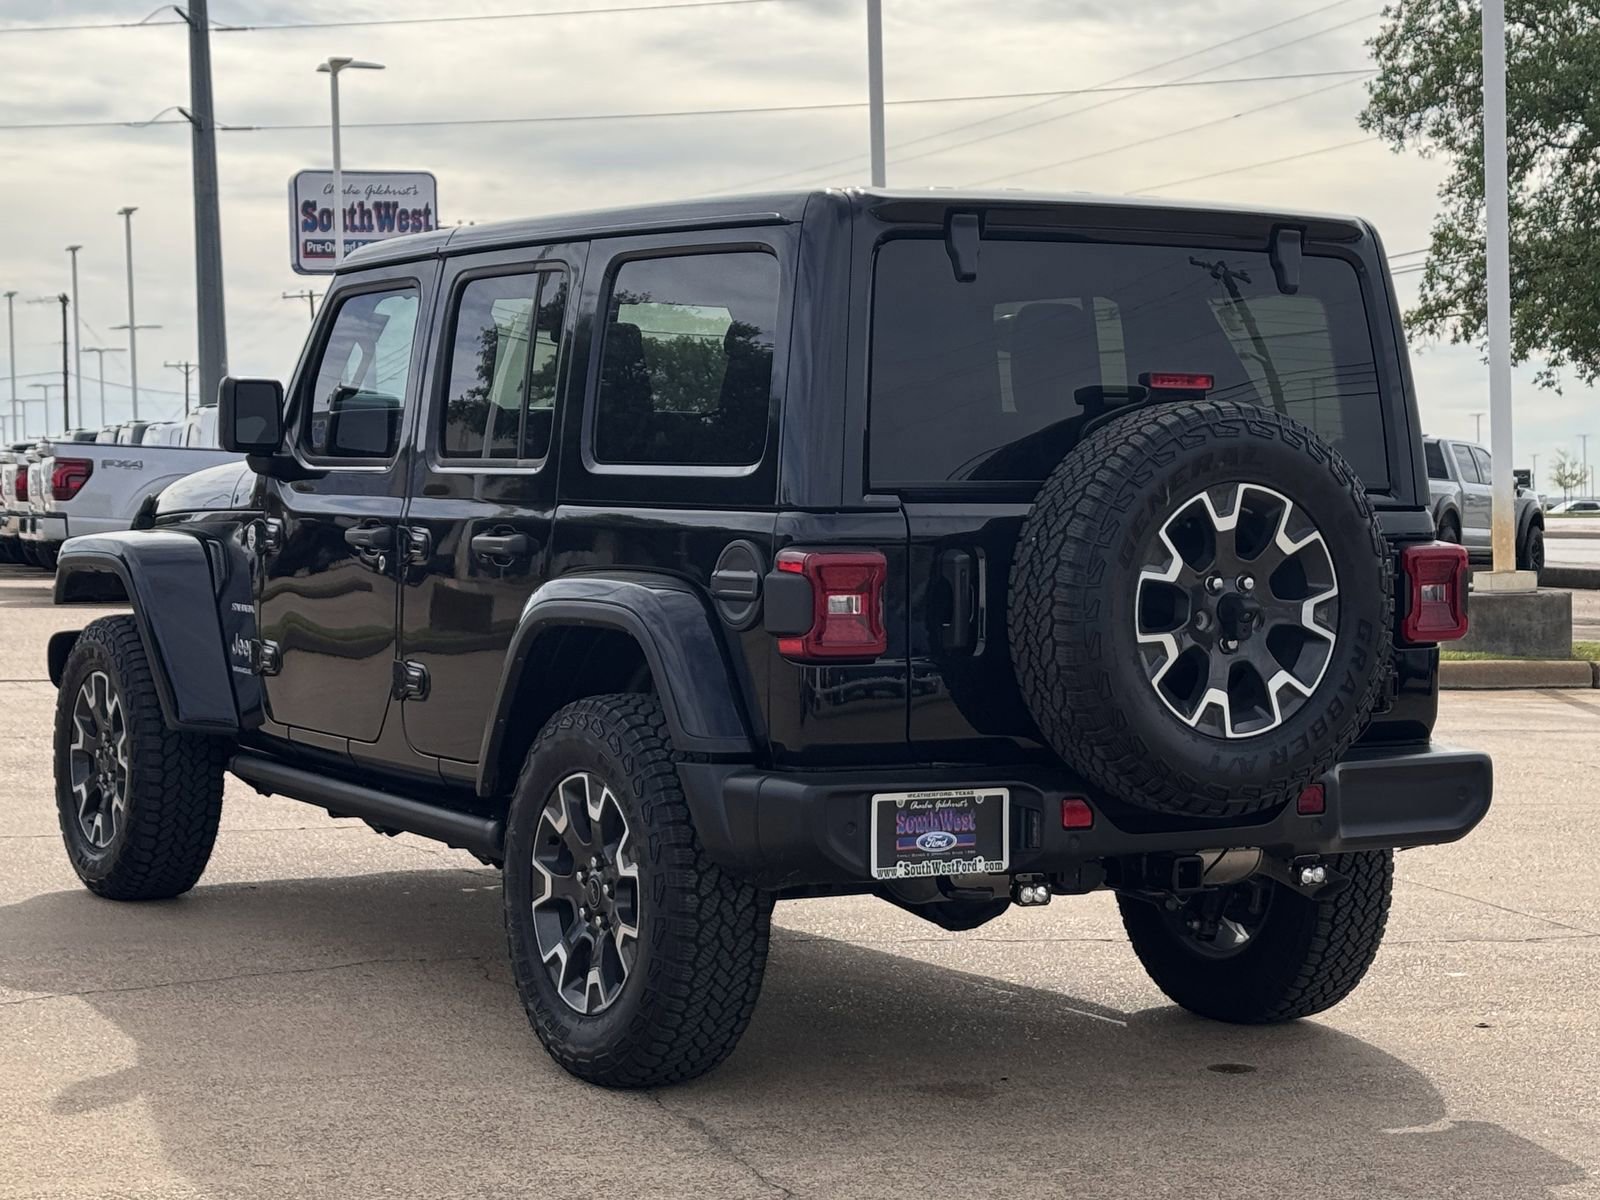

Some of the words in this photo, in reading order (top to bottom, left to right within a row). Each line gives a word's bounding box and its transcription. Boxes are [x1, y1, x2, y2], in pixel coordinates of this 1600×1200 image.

[323, 183, 361, 196] Chrlie
[364, 184, 419, 200] Gilchrist's
[306, 241, 356, 253] Pre-Oed
[101, 459, 144, 471] FX4
[1270, 618, 1373, 767] GRABBER
[896, 809, 976, 834] SouthWest
[925, 834, 948, 848] Ford
[876, 860, 1003, 878] www.SouthWestFord.com
